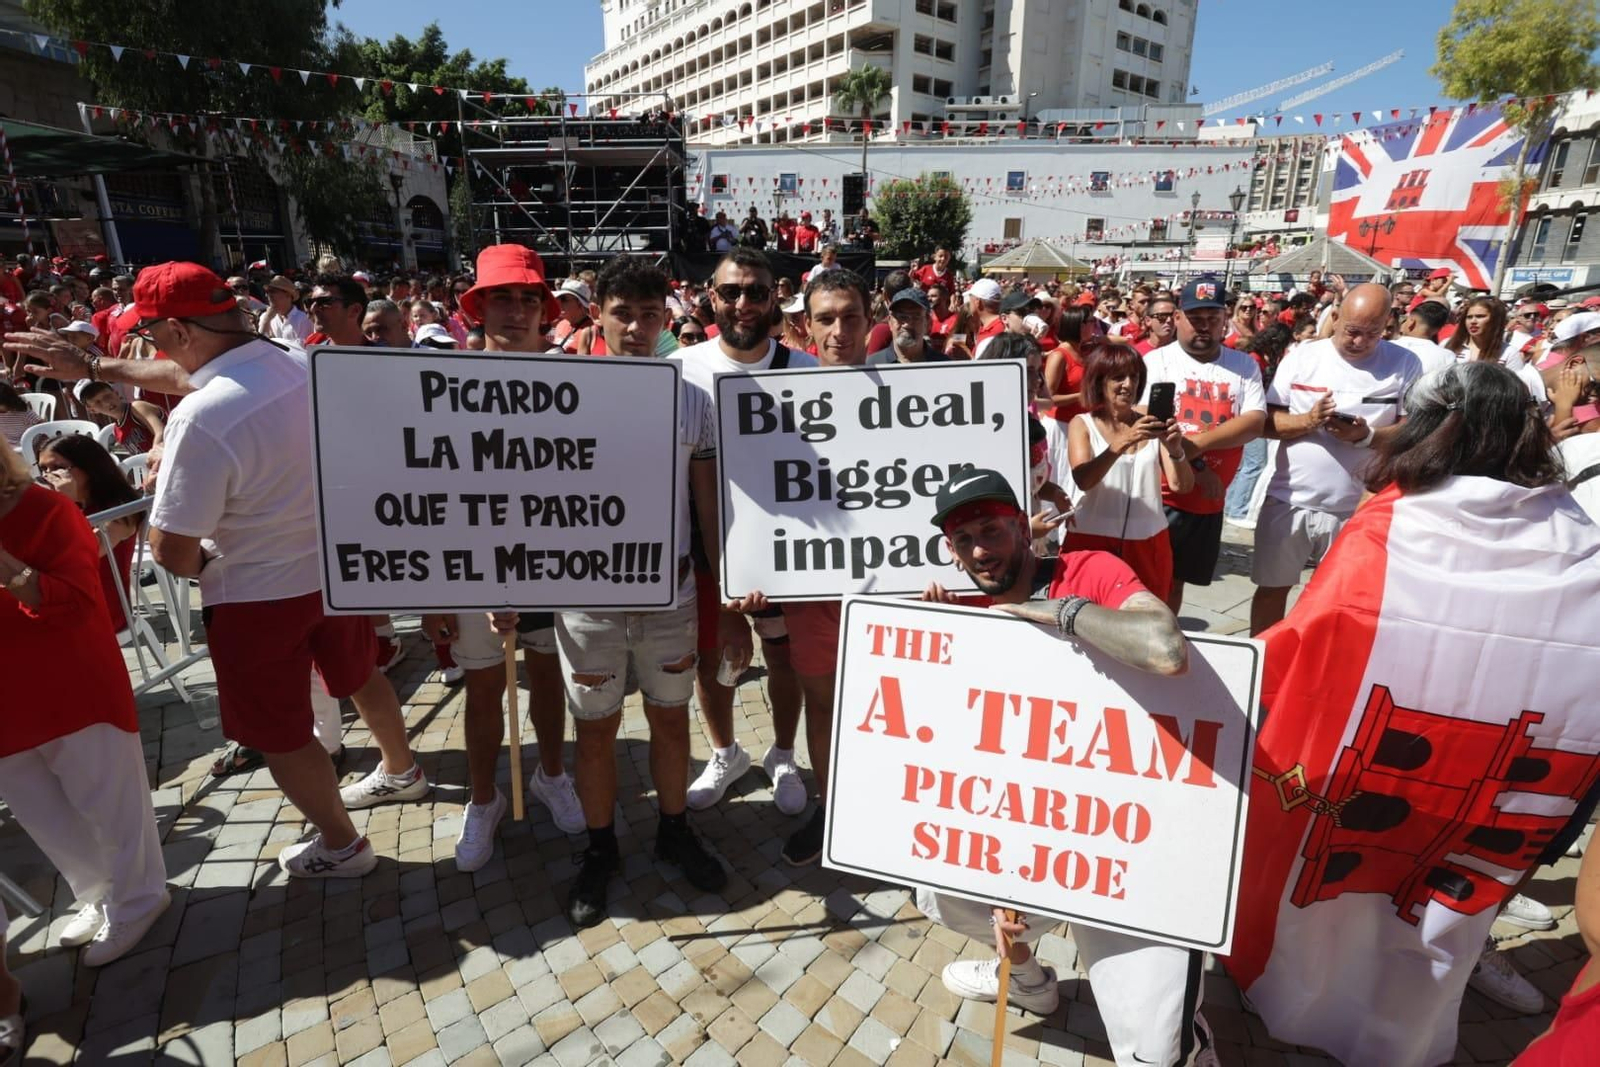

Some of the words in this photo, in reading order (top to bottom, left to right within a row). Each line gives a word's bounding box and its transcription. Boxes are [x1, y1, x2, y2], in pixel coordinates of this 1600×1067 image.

[737, 389, 838, 443] Big
[858, 380, 1006, 432] deal,
[403, 427, 460, 471] LA
[471, 428, 597, 472] MADRE
[374, 492, 448, 528] QUE
[460, 493, 509, 527] TE
[336, 543, 431, 583] ERES
[443, 549, 484, 582] EL
[494, 541, 663, 584] MEJOR!!!!
[774, 528, 955, 579] impac
[866, 624, 954, 665] THE
[856, 675, 934, 744] A.
[967, 687, 1224, 789] TEAM
[901, 764, 1152, 845] PICARDO
[911, 821, 1003, 875] SIR
[1018, 843, 1129, 900] JOE
